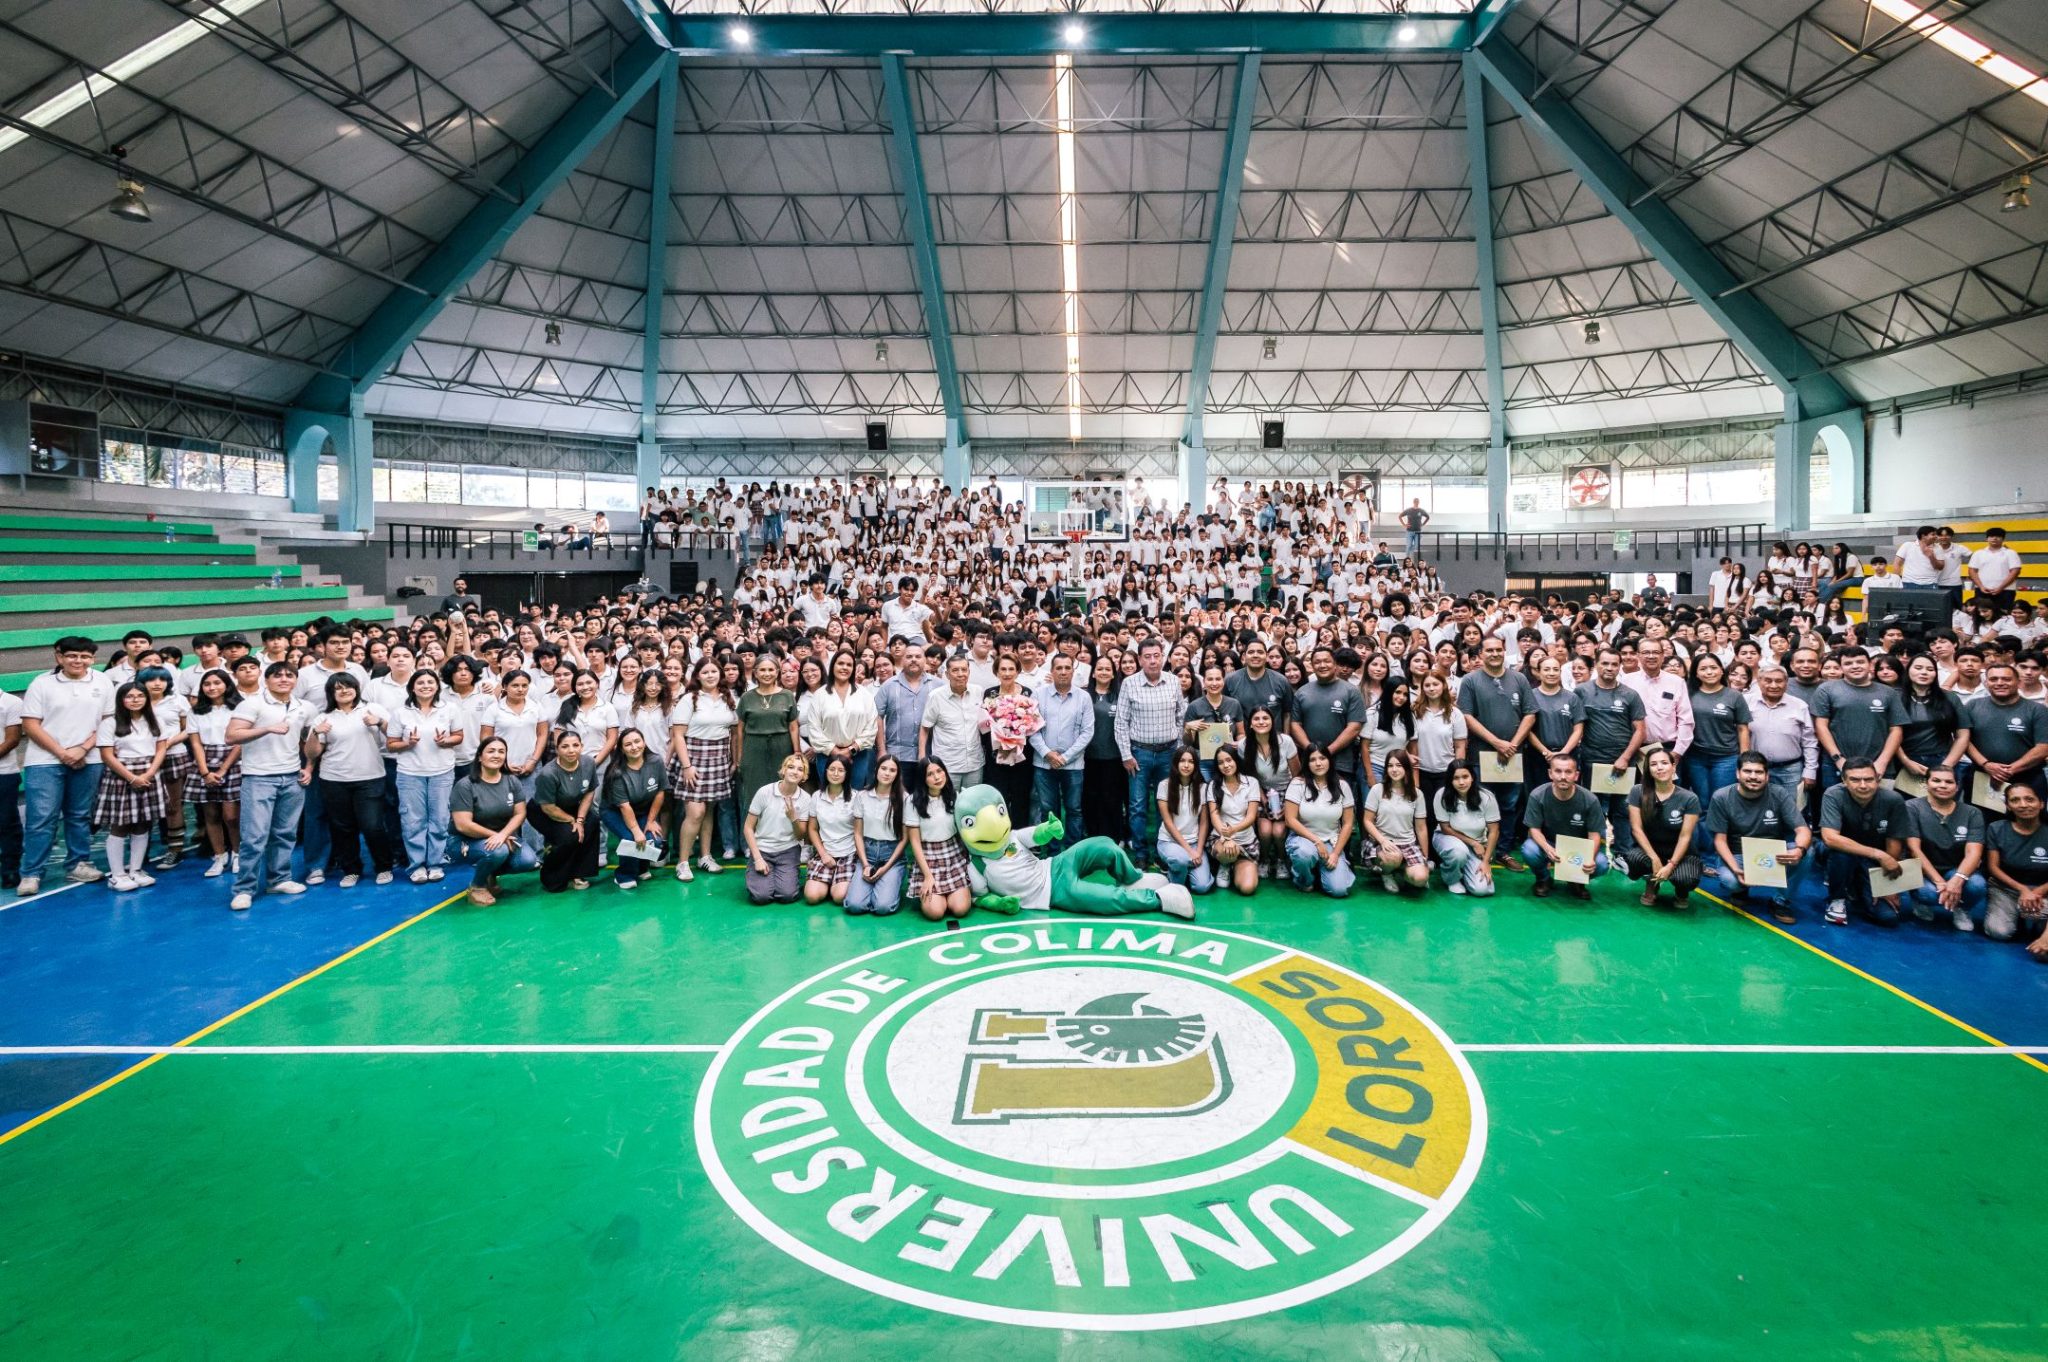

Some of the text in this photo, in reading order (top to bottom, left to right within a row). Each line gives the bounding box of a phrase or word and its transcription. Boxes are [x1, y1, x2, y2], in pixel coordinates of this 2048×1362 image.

[740, 927, 1354, 1289] UNIVERSIDAD DE COLIMA
[1259, 970, 1434, 1169] LOROS
